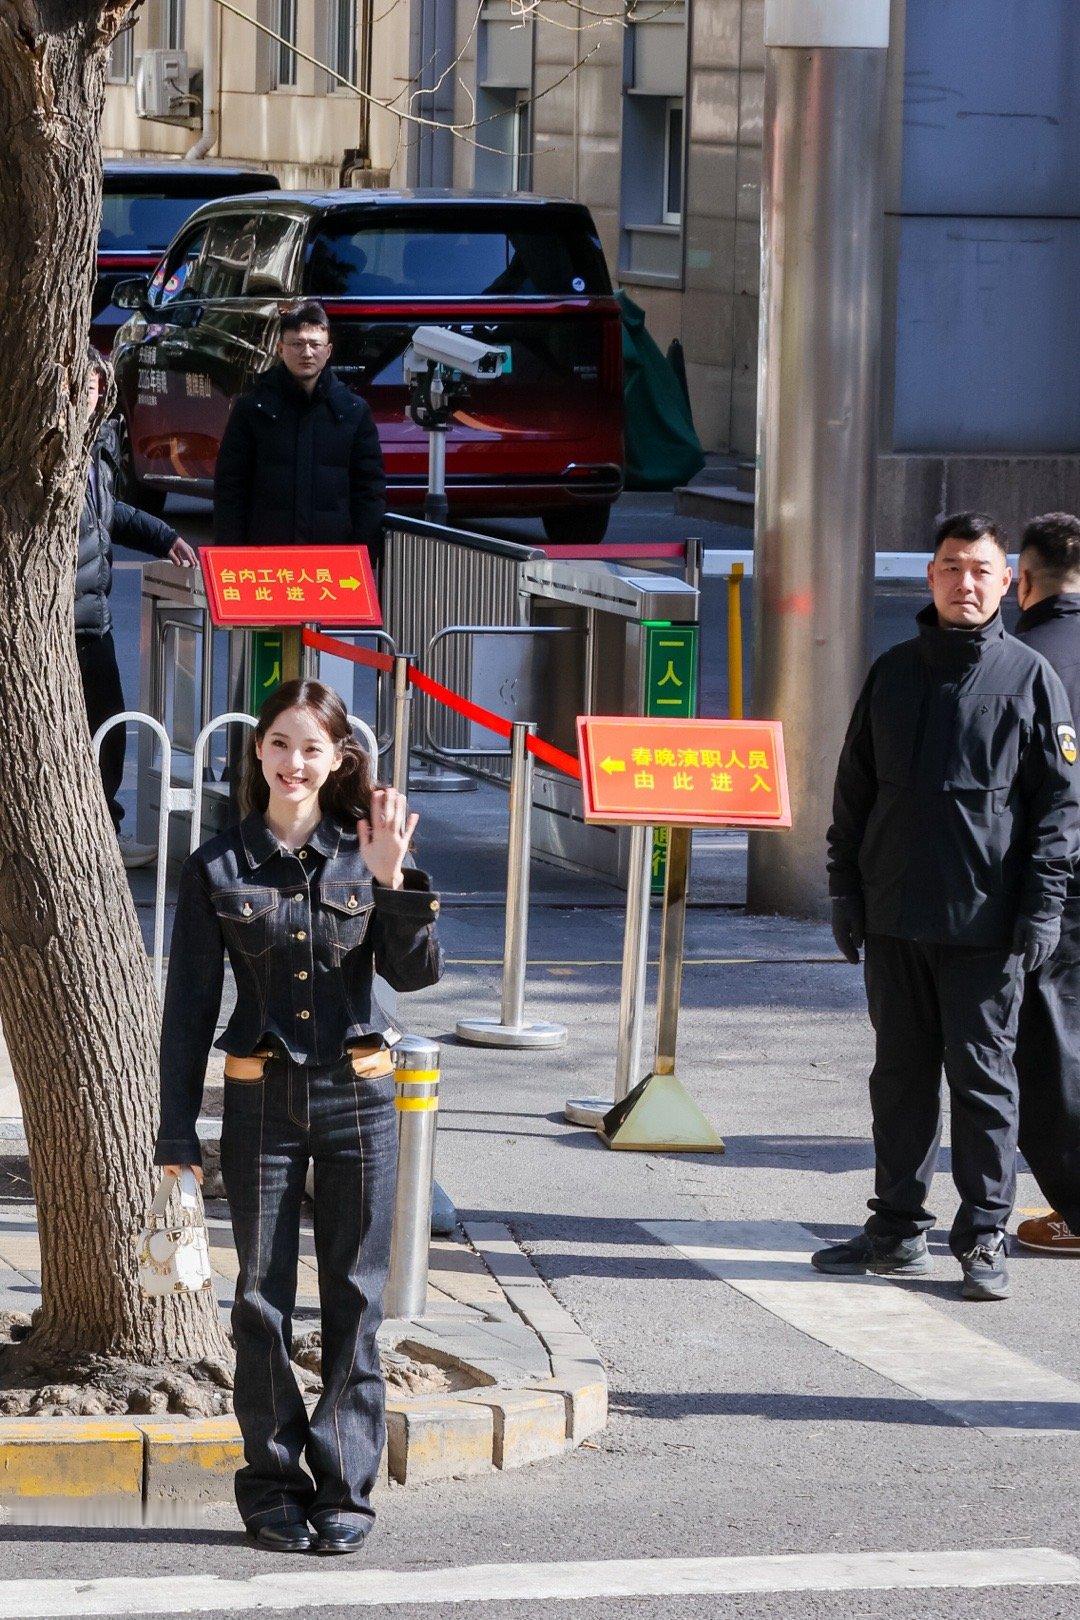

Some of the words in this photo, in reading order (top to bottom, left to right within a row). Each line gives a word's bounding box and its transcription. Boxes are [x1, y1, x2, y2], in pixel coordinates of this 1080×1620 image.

[219, 568, 334, 584] 台内工作人员
[631, 747, 769, 770] 春晚演职人员
